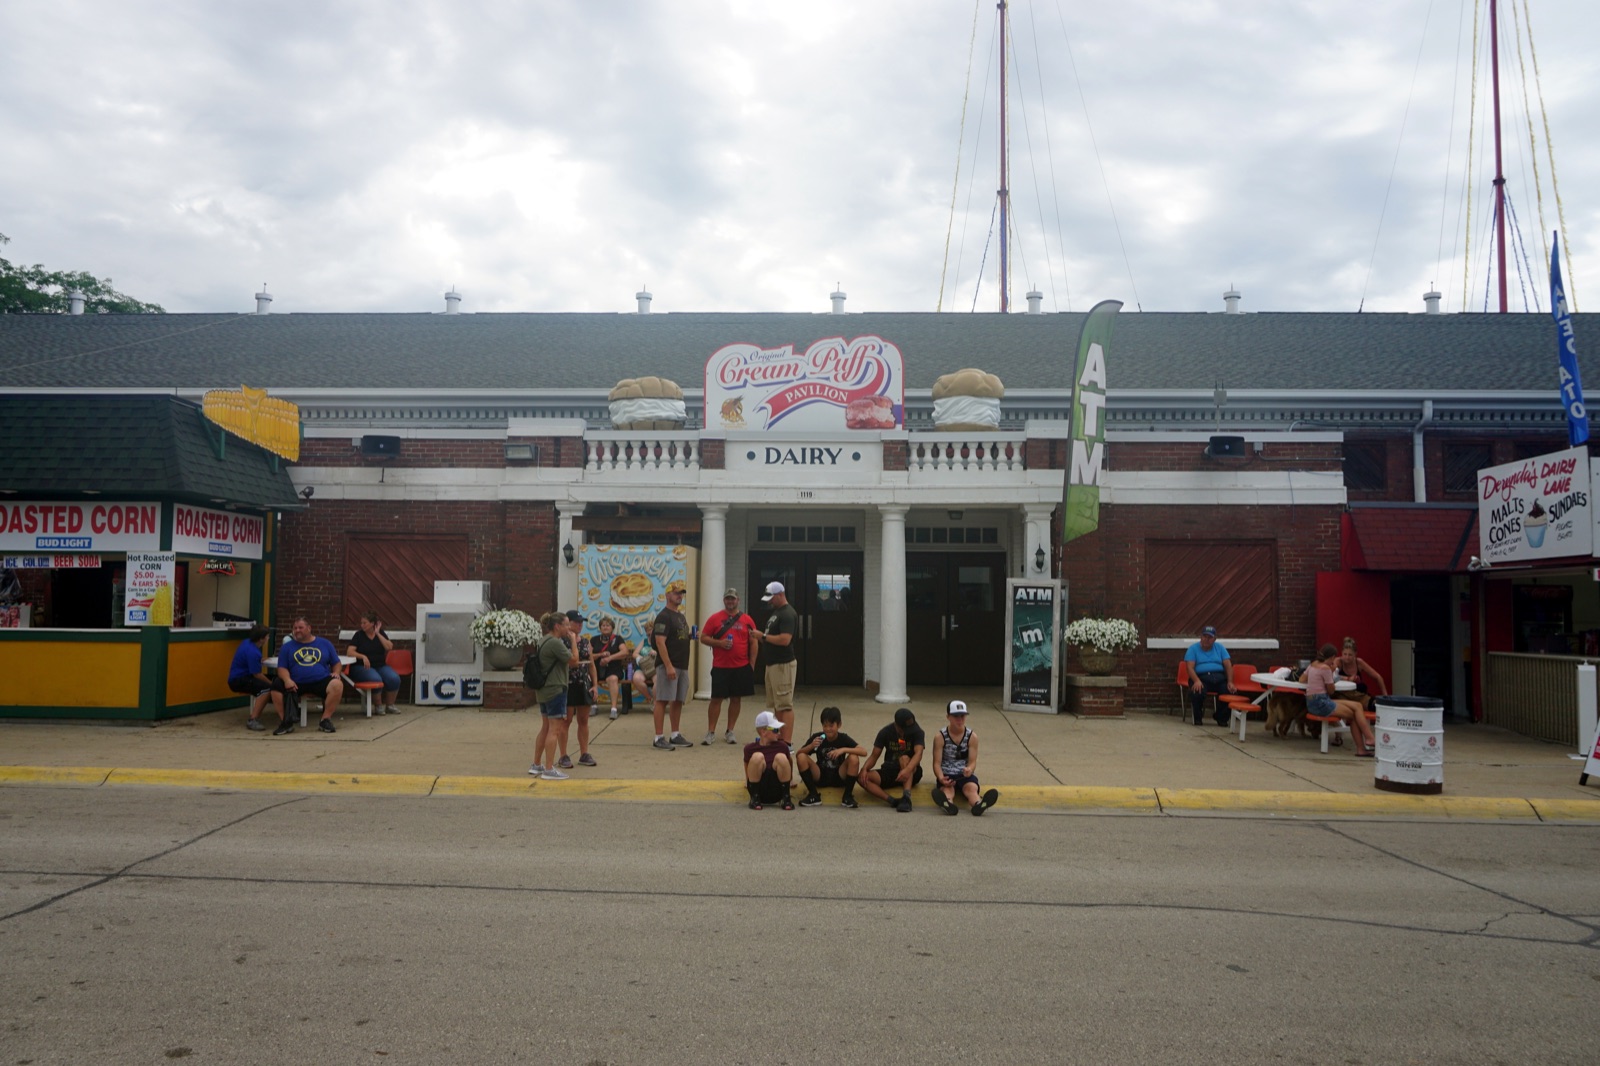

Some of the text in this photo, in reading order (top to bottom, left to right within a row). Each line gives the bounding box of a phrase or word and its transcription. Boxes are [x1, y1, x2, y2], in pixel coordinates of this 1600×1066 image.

[719, 344, 877, 383] Cream Puff
[750, 350, 786, 361] Original
[785, 384, 849, 403] PAVILION
[1069, 343, 1106, 487] ATM
[764, 447, 843, 465] DAIRY
[1540, 458, 1577, 479] DAIRY
[1543, 477, 1572, 496] LANE
[1490, 497, 1525, 525] MALTS
[1548, 491, 1587, 523] SUNDAES
[90, 504, 157, 534] CORN
[176, 507, 262, 544] ROASTED CORN
[1489, 517, 1521, 544] CONES
[37, 539, 90, 548] BUD LIGHT
[6, 557, 18, 567] ICE
[54, 555, 74, 567] BEER
[78, 555, 100, 567] SODA
[127, 554, 175, 562] Hot Roasted
[140, 562, 162, 571] CORN
[134, 571, 154, 579] $5.00
[155, 579, 168, 588] $16
[1015, 588, 1052, 600] ATM
[420, 673, 481, 701] ICE
